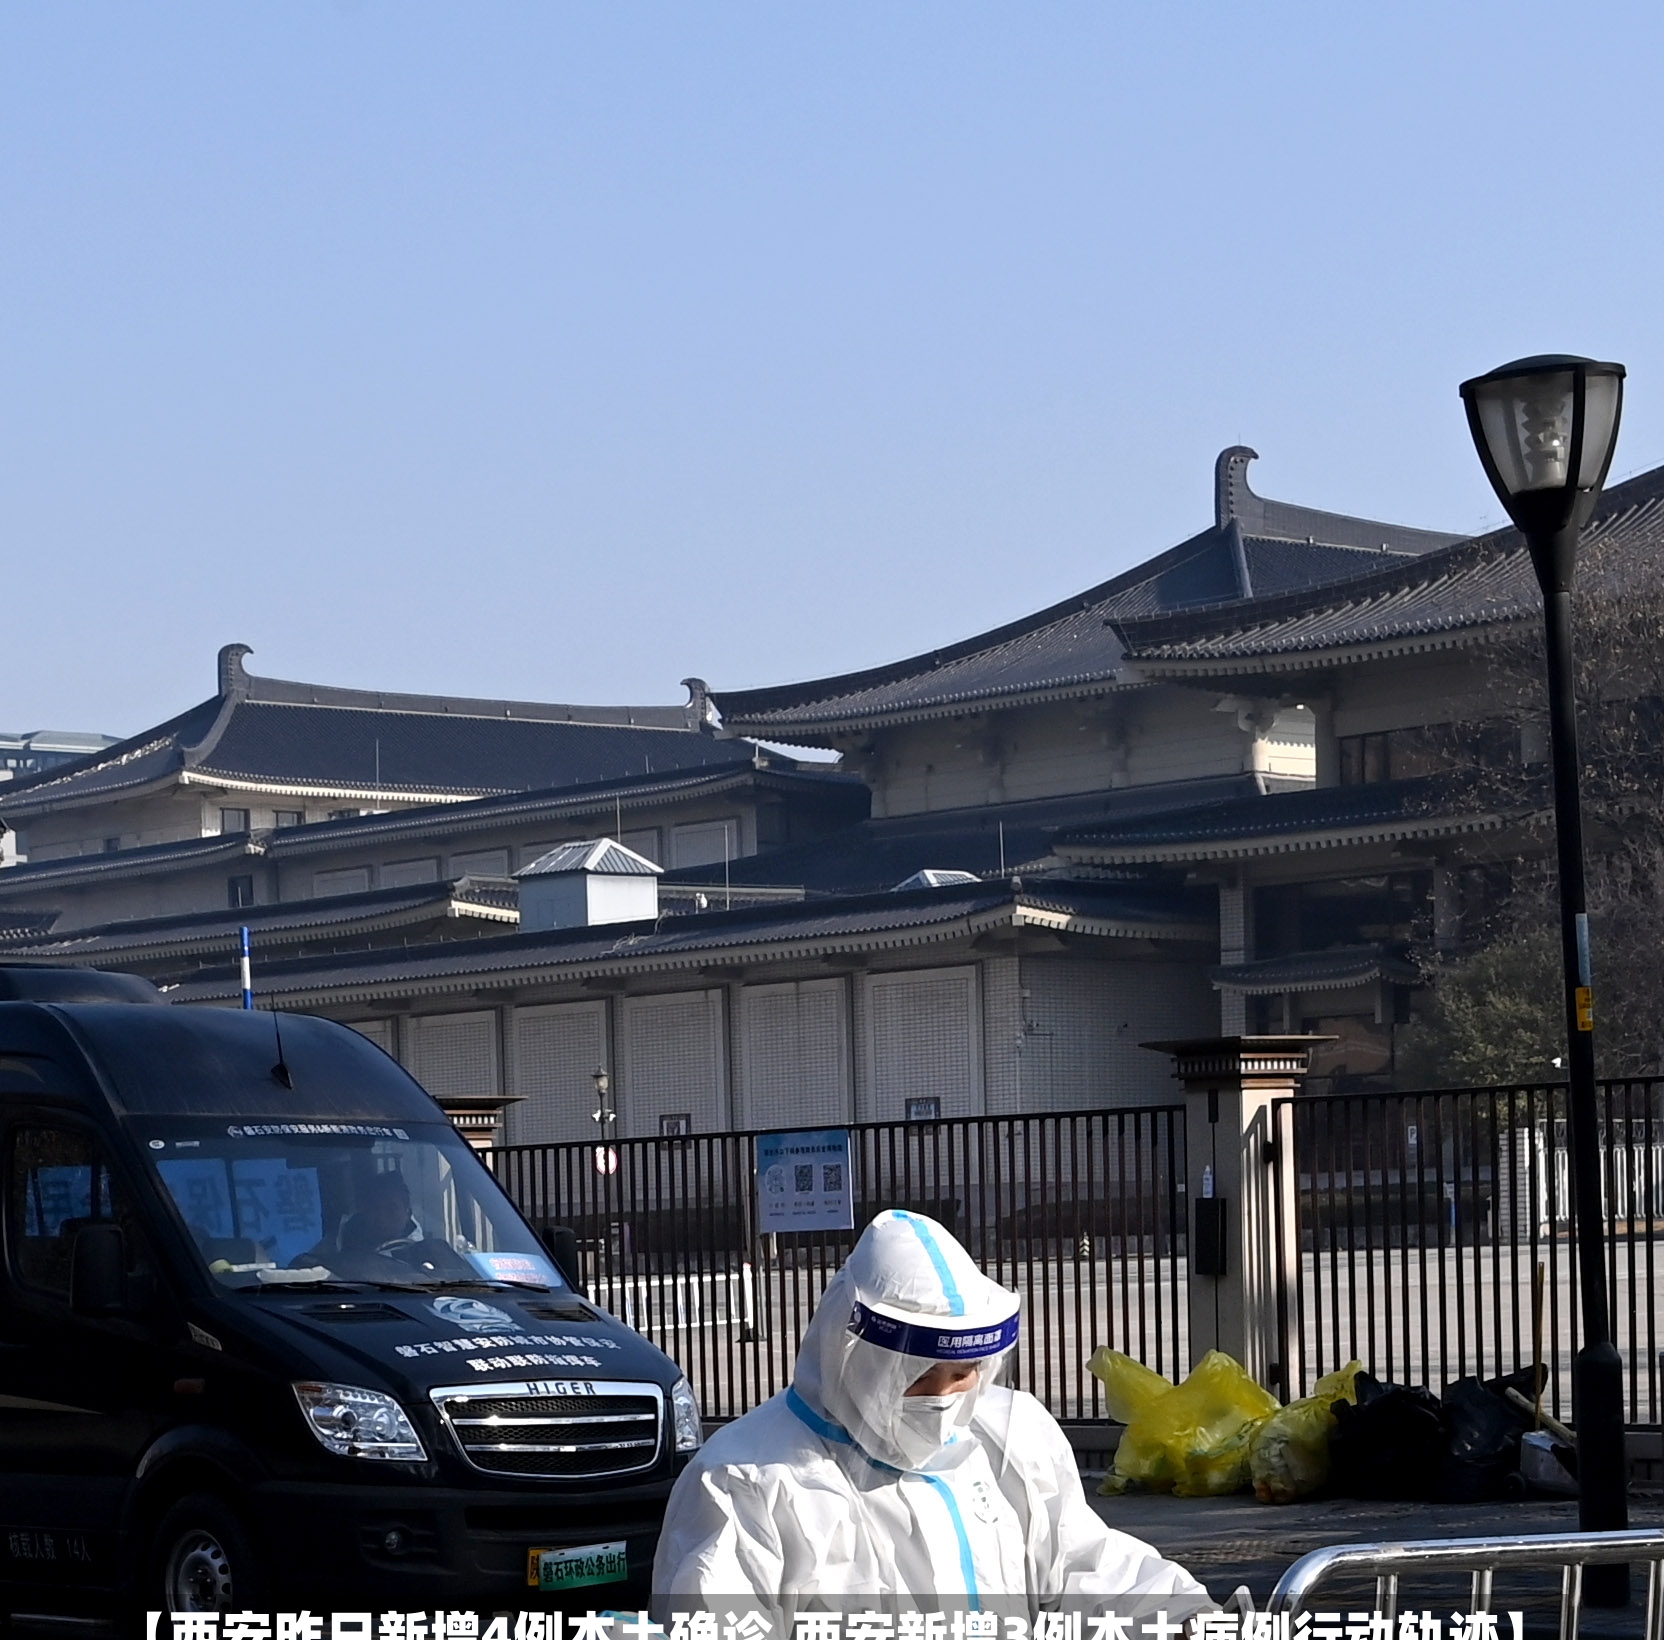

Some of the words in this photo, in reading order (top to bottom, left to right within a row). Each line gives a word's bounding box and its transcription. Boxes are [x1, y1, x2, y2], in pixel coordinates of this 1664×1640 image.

[937, 1329, 1002, 1348] 医用隔离面罩
[526, 1382, 597, 1395] HIGER
